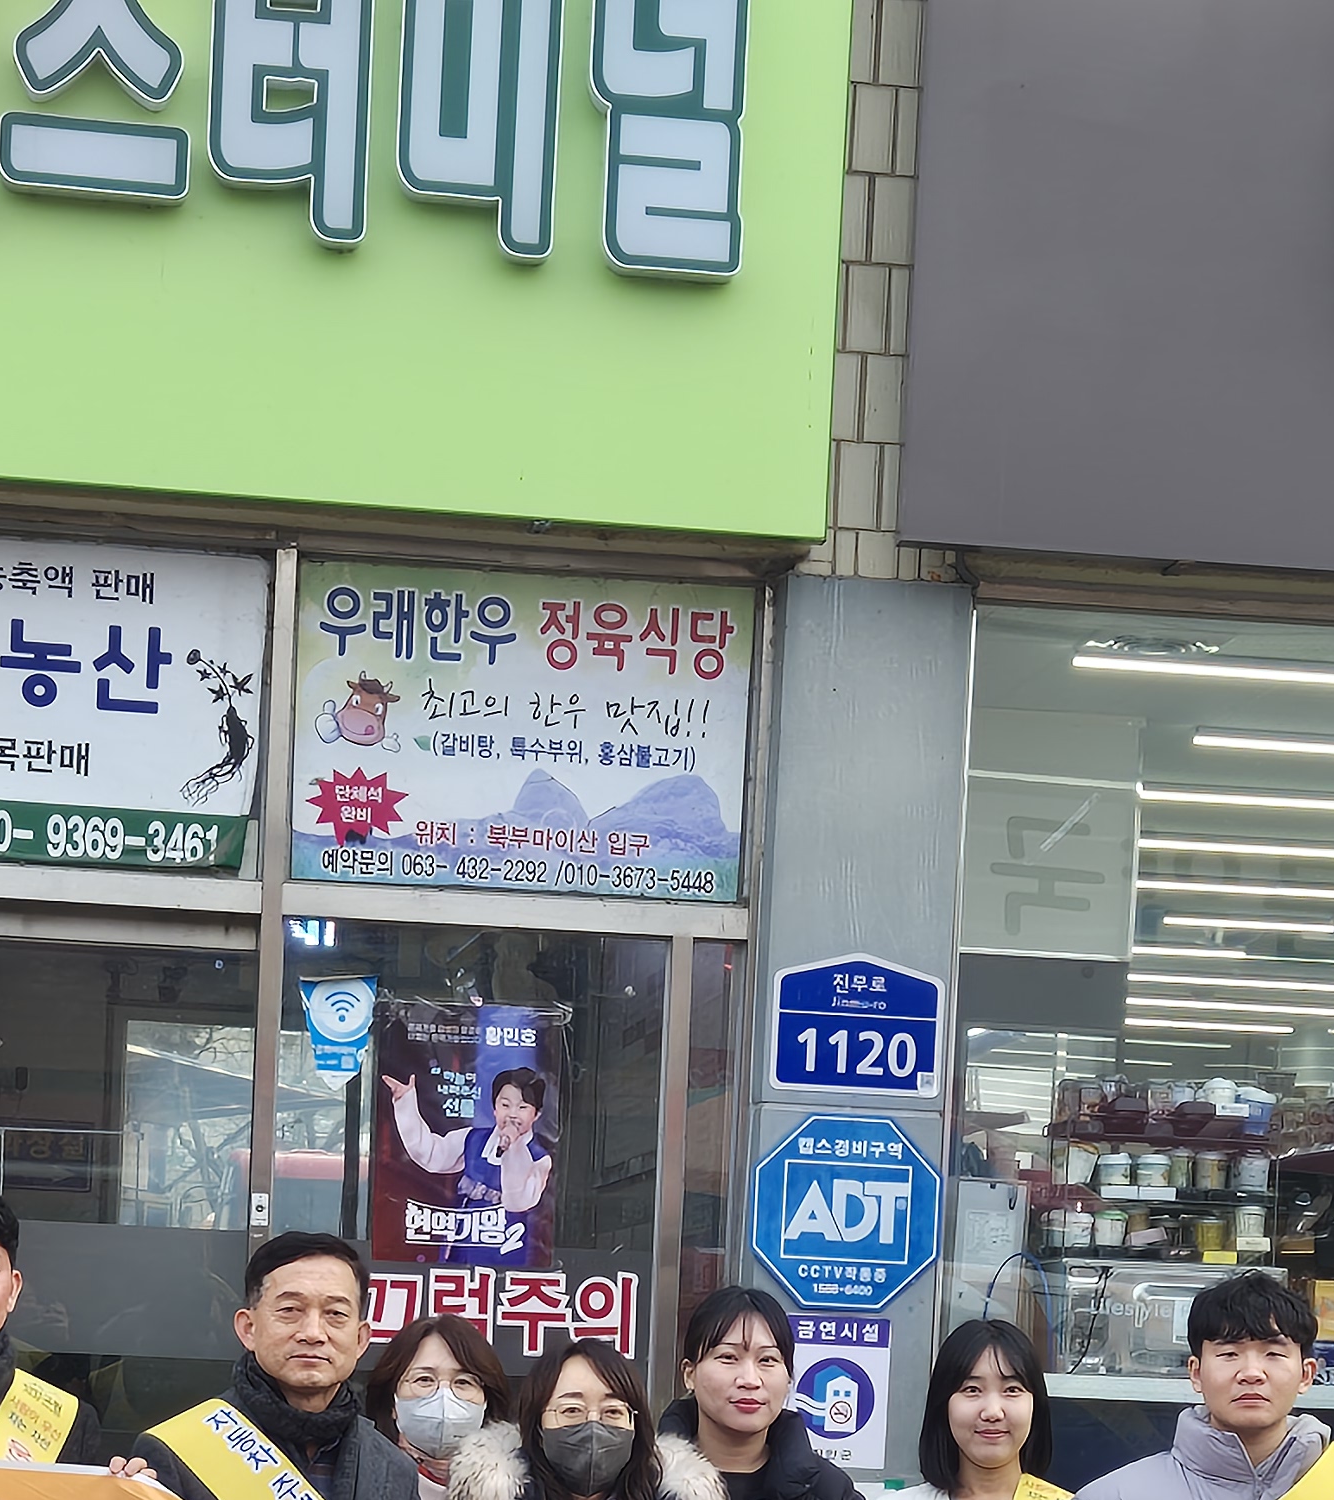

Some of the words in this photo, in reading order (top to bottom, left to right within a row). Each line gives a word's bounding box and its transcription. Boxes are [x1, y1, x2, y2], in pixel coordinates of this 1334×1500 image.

[89, 568, 157, 606] 판매
[319, 585, 517, 666] 우래한우
[539, 600, 735, 680] 정육식당
[421, 678, 510, 720] 최고의
[529, 693, 588, 730] 한우
[45, 813, 220, 865] 9369-3461
[415, 820, 458, 847] 위치
[487, 824, 599, 854] 북부마이산
[608, 832, 651, 859] 입구
[322, 847, 395, 877] 예약문의
[455, 856, 548, 884] 432-2292
[832, 972, 888, 994] 진무로
[485, 1026, 538, 1047] 황민호
[796, 1027, 918, 1079] 1120
[783, 1178, 910, 1245] ADT
[368, 1266, 641, 1360] 끄럼주의
[797, 1319, 881, 1343] 금연시설
[203, 1407, 280, 1472] 자동차
